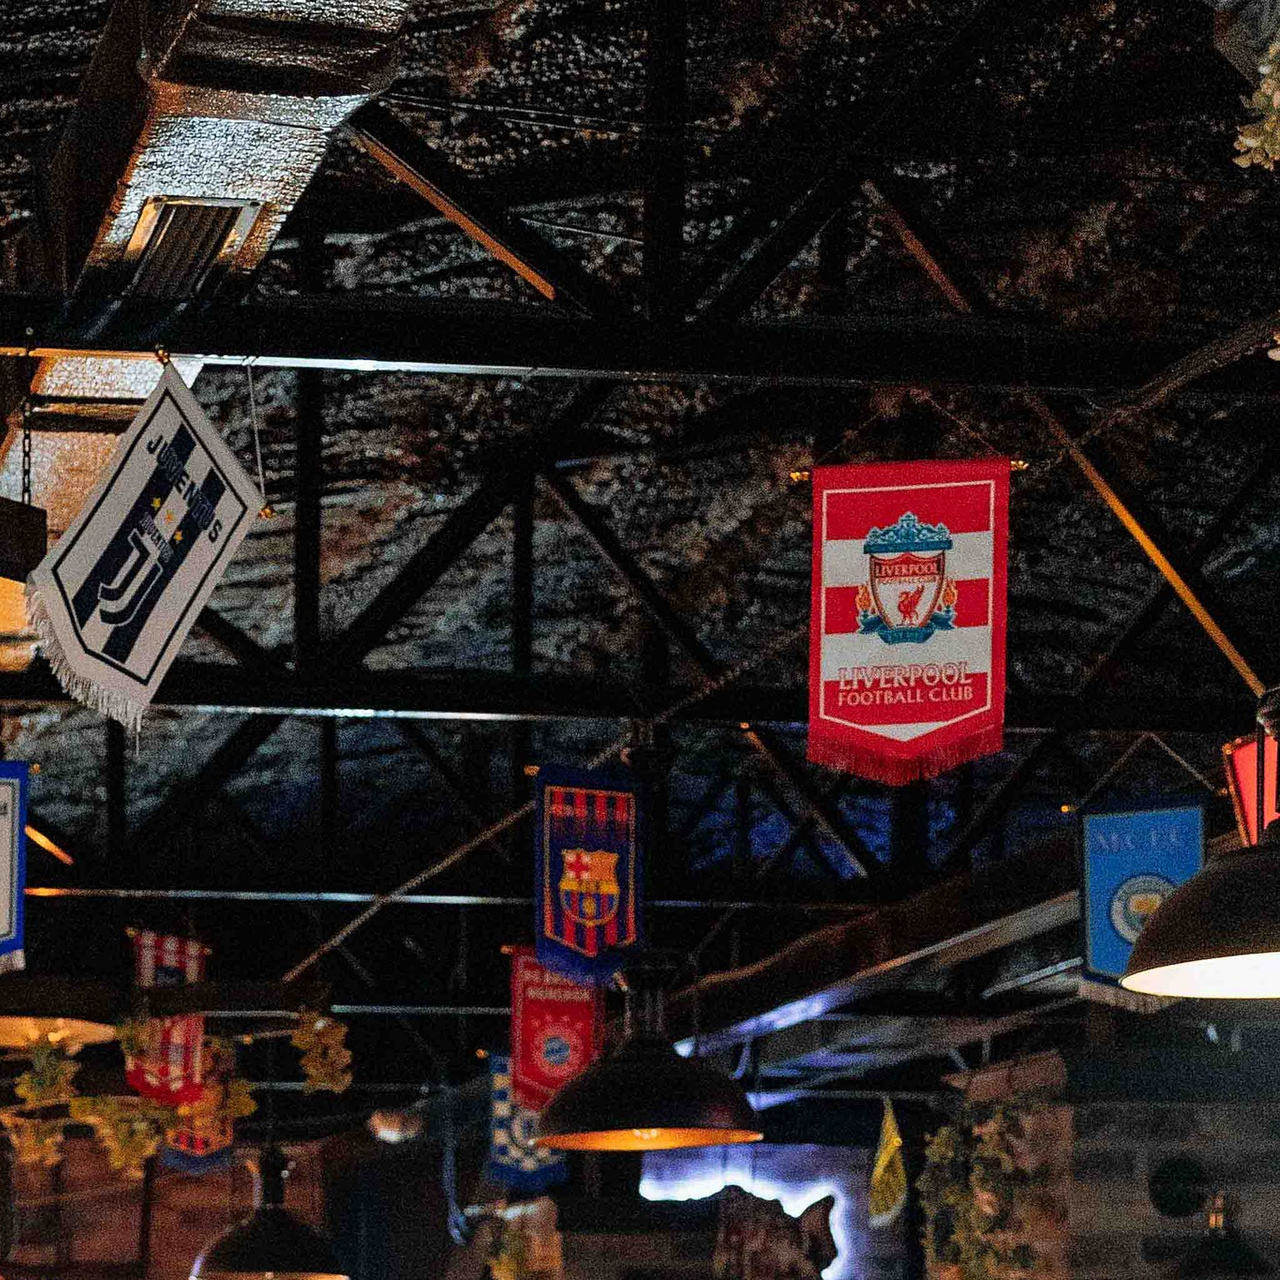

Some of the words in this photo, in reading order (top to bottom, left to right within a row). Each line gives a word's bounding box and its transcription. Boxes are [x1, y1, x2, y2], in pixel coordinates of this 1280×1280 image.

[147, 435, 222, 543] JUVENTUS
[875, 562, 938, 577] LIVERPOOL
[838, 661, 973, 690] LIVERPOOL
[838, 689, 924, 707] FOOTBALL
[928, 686, 973, 703] CLUB
